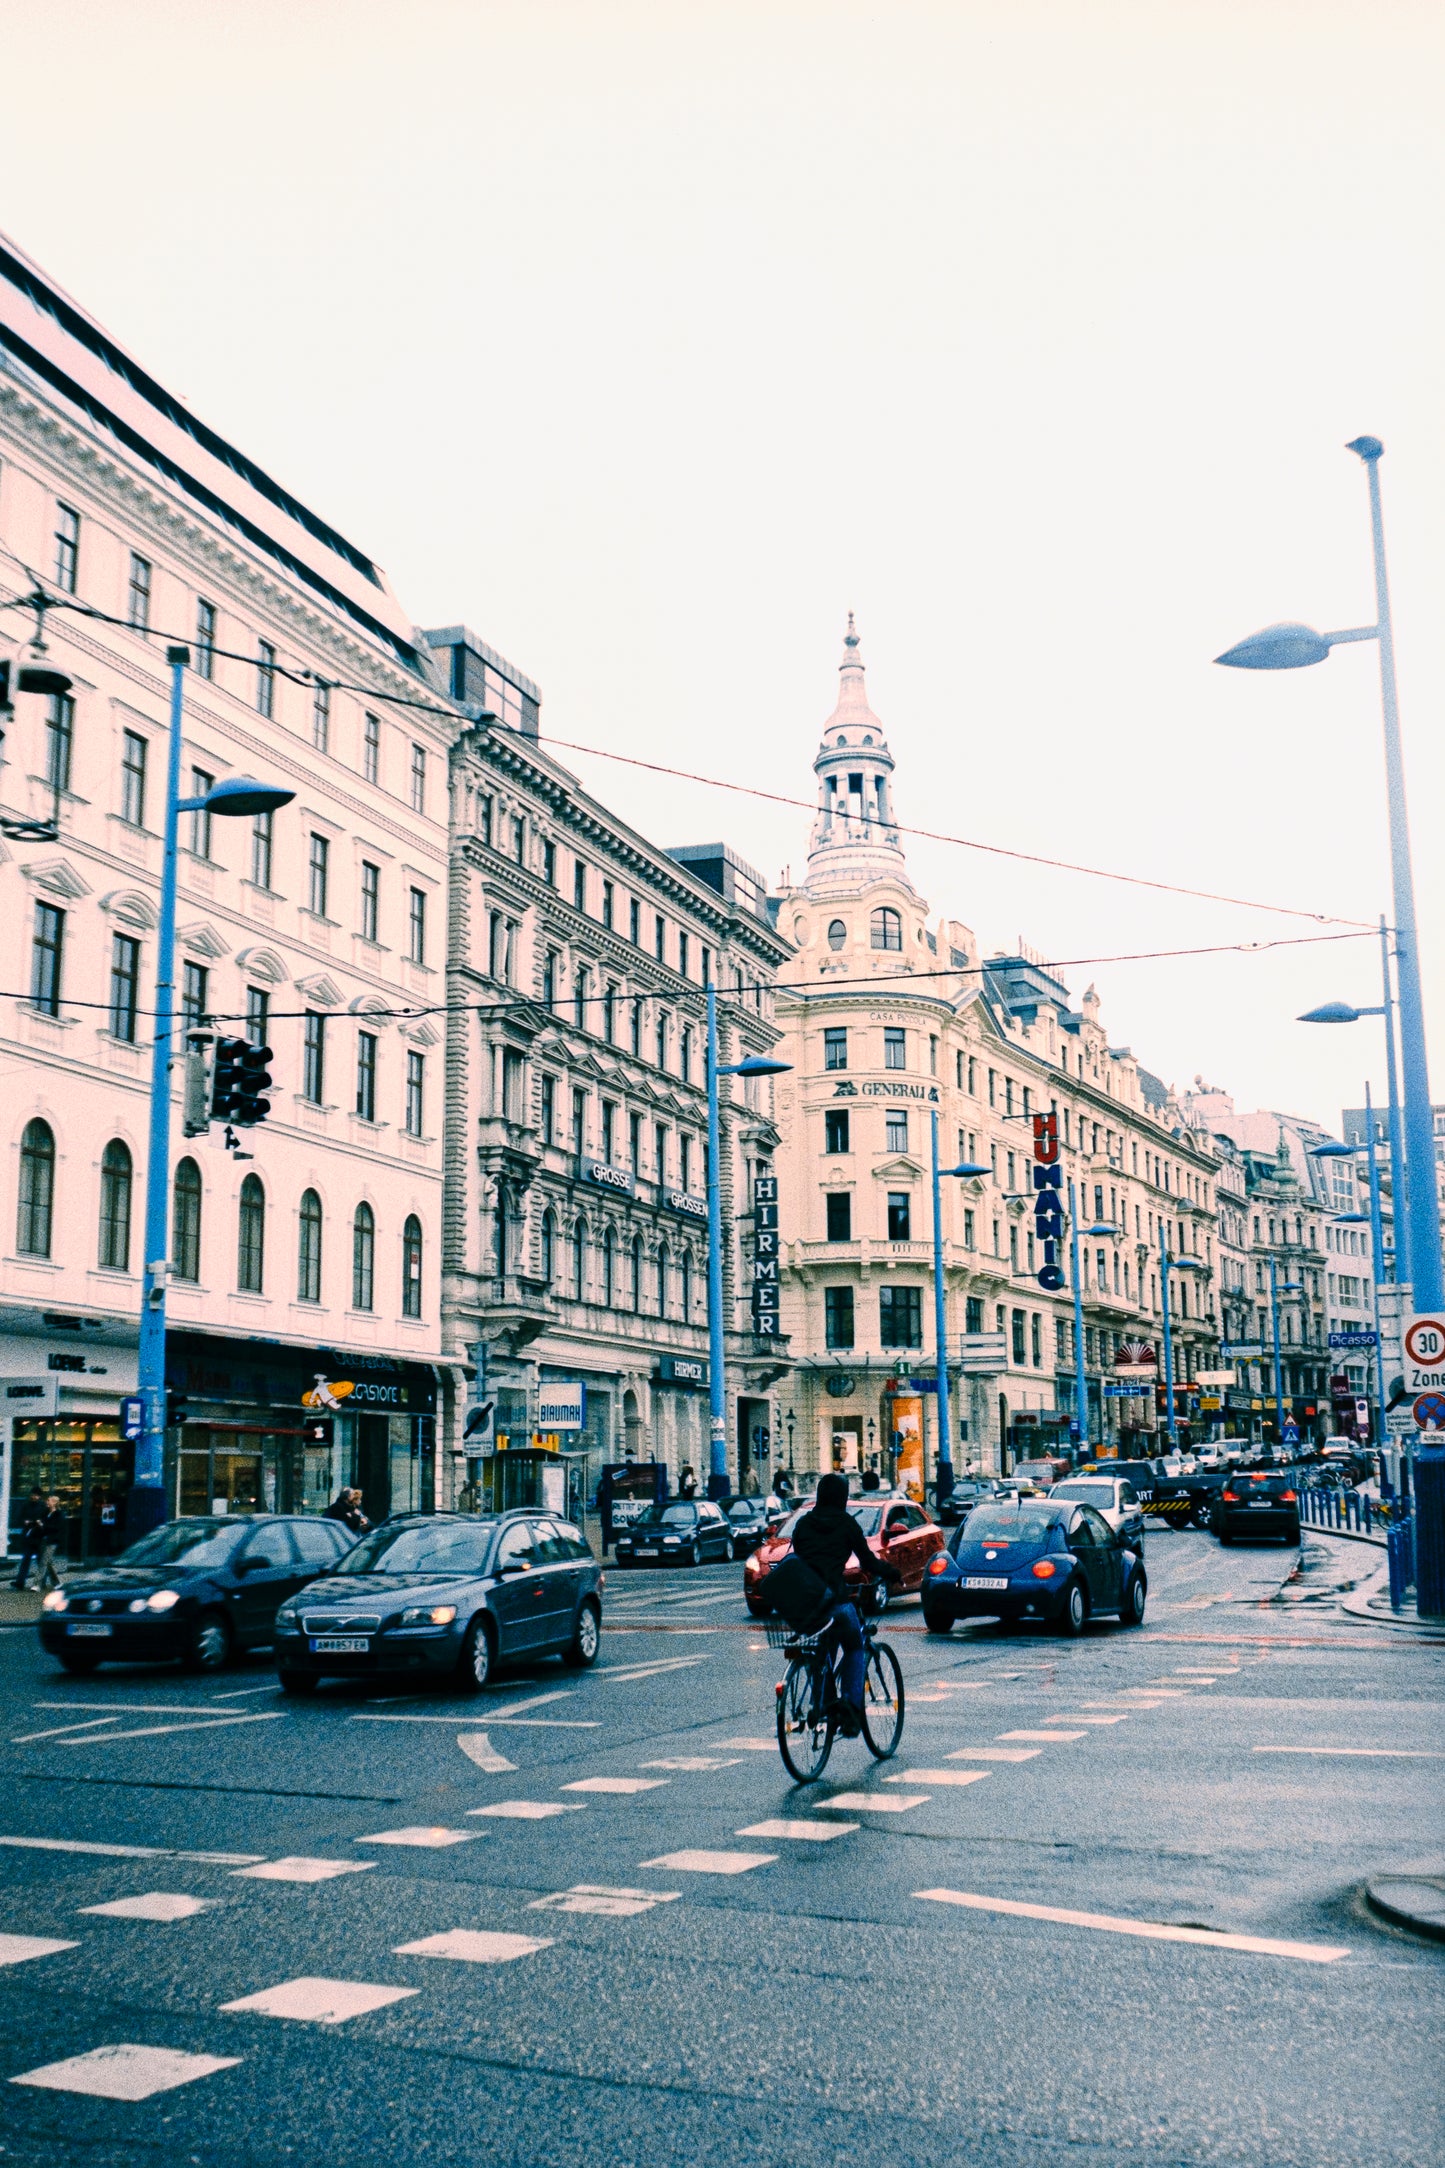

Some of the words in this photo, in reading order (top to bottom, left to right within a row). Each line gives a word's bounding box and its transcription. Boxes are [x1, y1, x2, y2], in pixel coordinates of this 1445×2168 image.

[869, 1012, 894, 1021] CASA
[862, 1082, 925, 1099] GENERALI
[593, 1164, 631, 1189] GROSSE
[1033, 1114, 1065, 1291] HUMANIC
[755, 1180, 776, 1334] HIRMER
[1330, 1335, 1375, 1345] Picasso
[1418, 1332, 1438, 1354] 30
[674, 1360, 702, 1380] HIRMER
[1412, 1369, 1445, 1387] Zone
